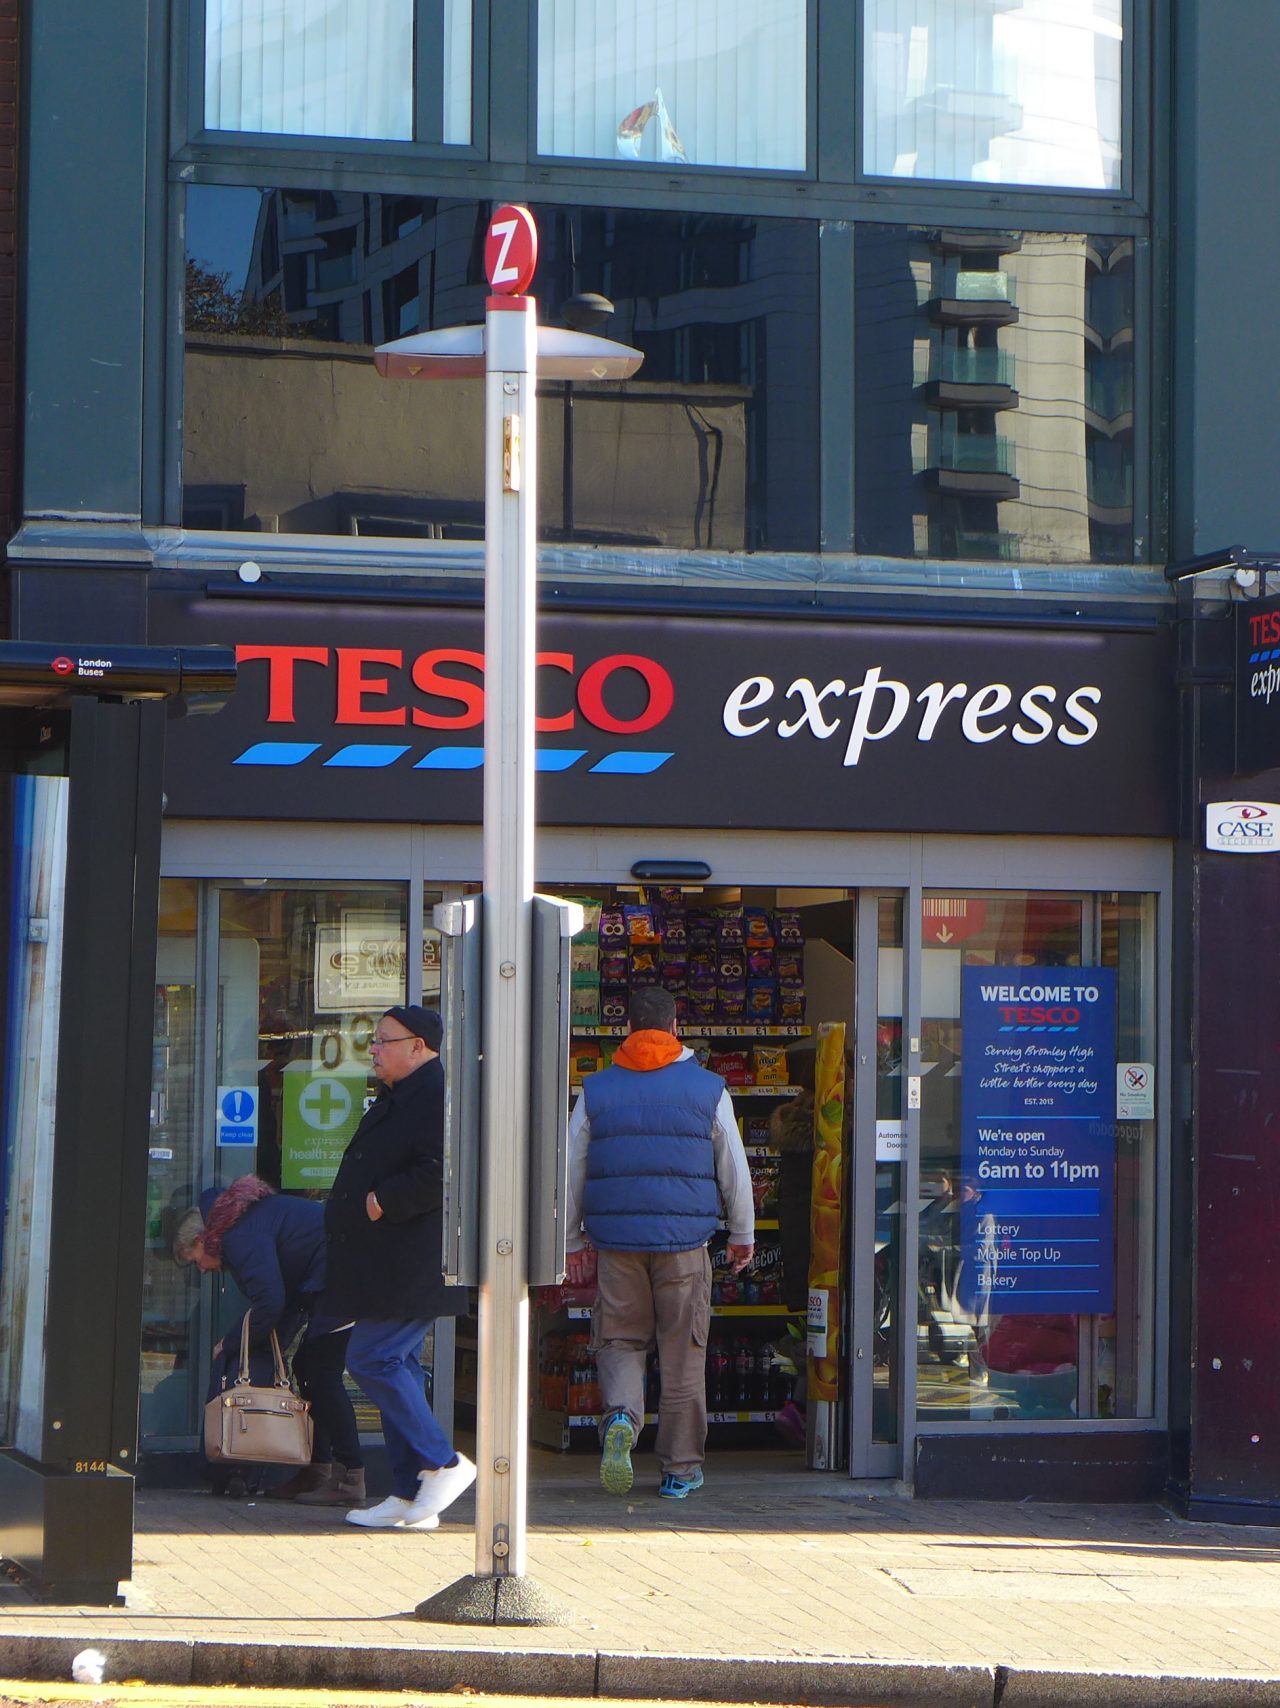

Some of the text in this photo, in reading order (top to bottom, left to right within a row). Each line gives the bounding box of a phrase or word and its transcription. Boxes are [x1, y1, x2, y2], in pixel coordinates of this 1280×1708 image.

[491, 219, 518, 284] Z
[79, 658, 112, 668] London
[78, 668, 104, 676] Buses
[723, 666, 1101, 766] express
[1217, 821, 1273, 837] CASE
[981, 985, 1099, 1003] WELCOME TO
[998, 1007, 1080, 1025] TESCO
[585, 1027, 597, 1035] £1
[611, 1027, 624, 1036] £1
[700, 1027, 712, 1036] £1
[726, 1027, 738, 1036] £1
[756, 1027, 768, 1036] £1
[787, 1027, 799, 1036] £1
[984, 1045, 1094, 1061] Serving Bromley High
[1032, 1062, 1075, 1077] shoppers
[980, 1078, 1098, 1094] little better every day
[978, 1129, 1045, 1143] We're open
[289, 1147, 343, 1160] health zo
[755, 1148, 767, 1156] £1
[978, 1146, 1065, 1157] Monday to Sunday
[978, 1160, 1099, 1182] 6am to 11pm
[977, 1222, 1020, 1239] Lottery
[977, 1248, 1061, 1262] Mobile Top Up
[977, 1273, 1018, 1289] Bakery
[809, 1296, 822, 1307] SCO
[581, 1309, 593, 1317] £1
[714, 1413, 725, 1422] £1
[765, 1413, 776, 1422] £1
[75, 1461, 105, 1472] 8144
